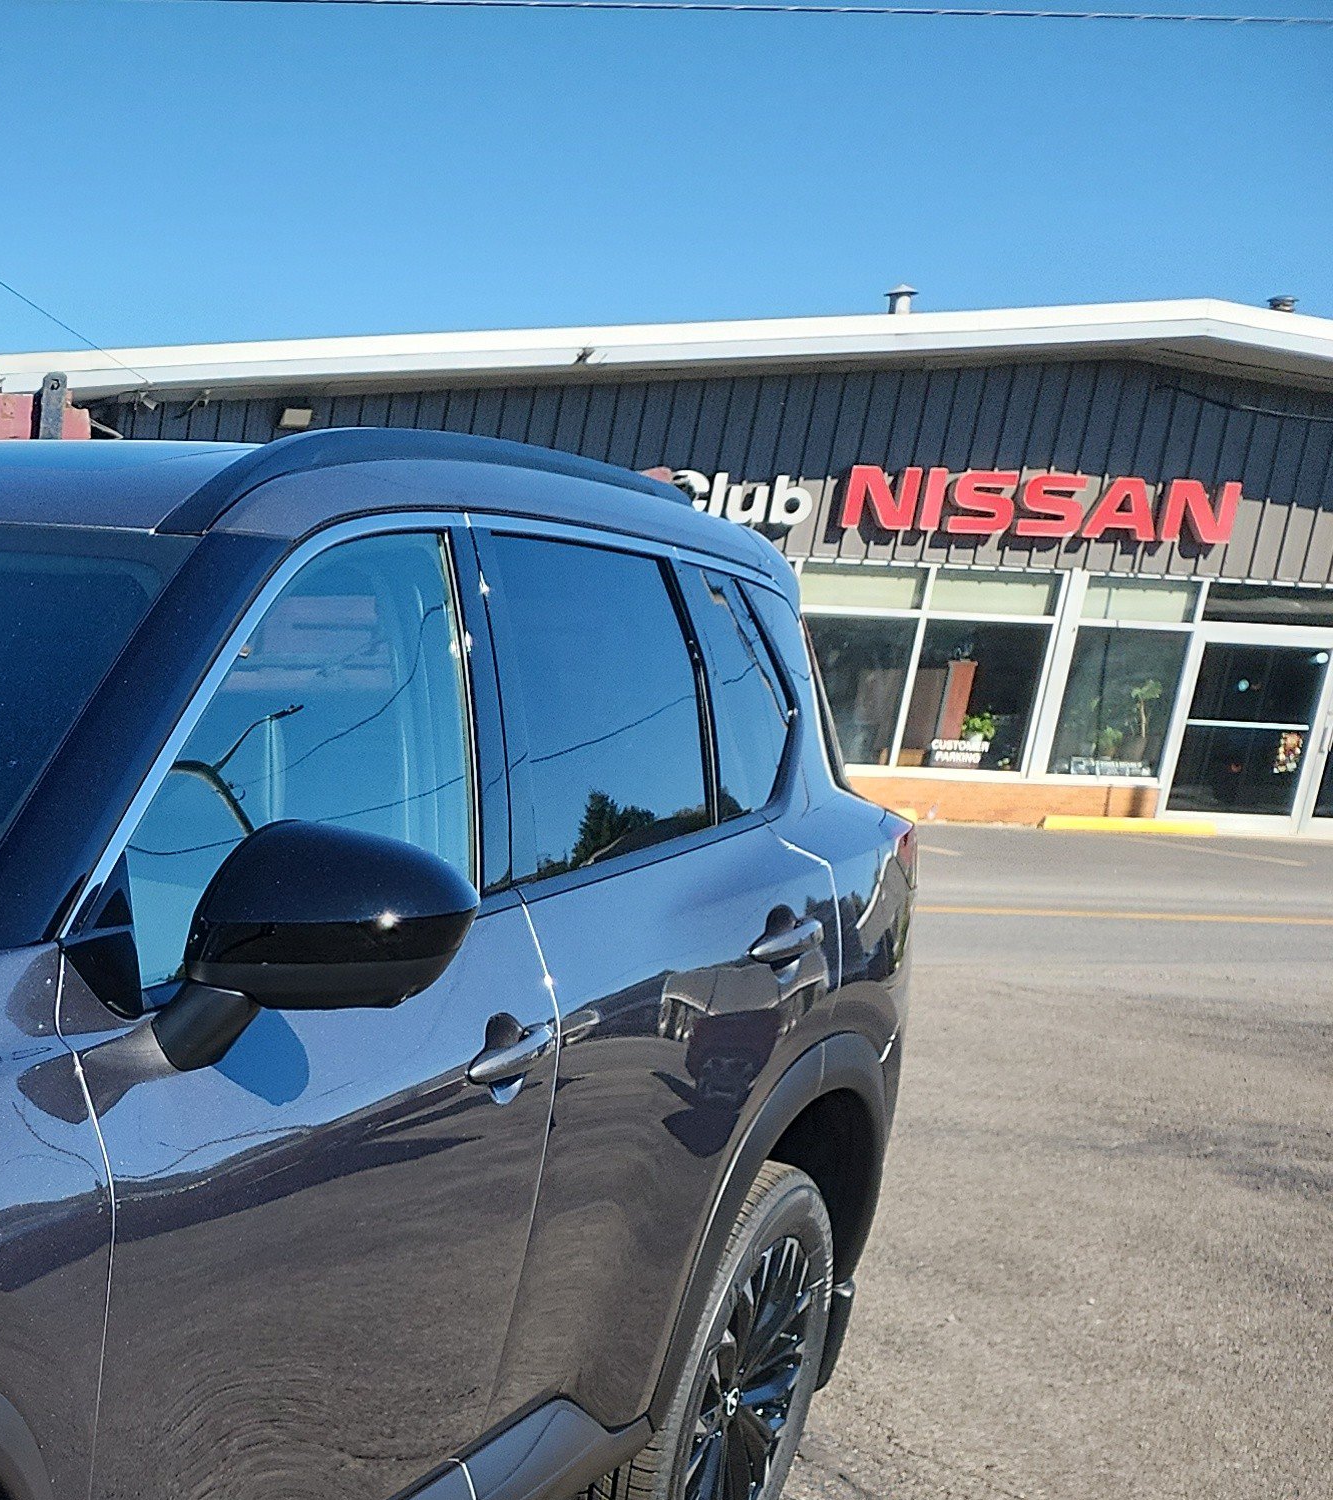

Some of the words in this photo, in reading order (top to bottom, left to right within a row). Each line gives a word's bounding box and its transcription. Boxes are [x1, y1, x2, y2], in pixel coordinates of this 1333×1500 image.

[841, 465, 1242, 545] NISSAN
[931, 738, 990, 753] CUSTOMER
[935, 750, 982, 764] PARKING
